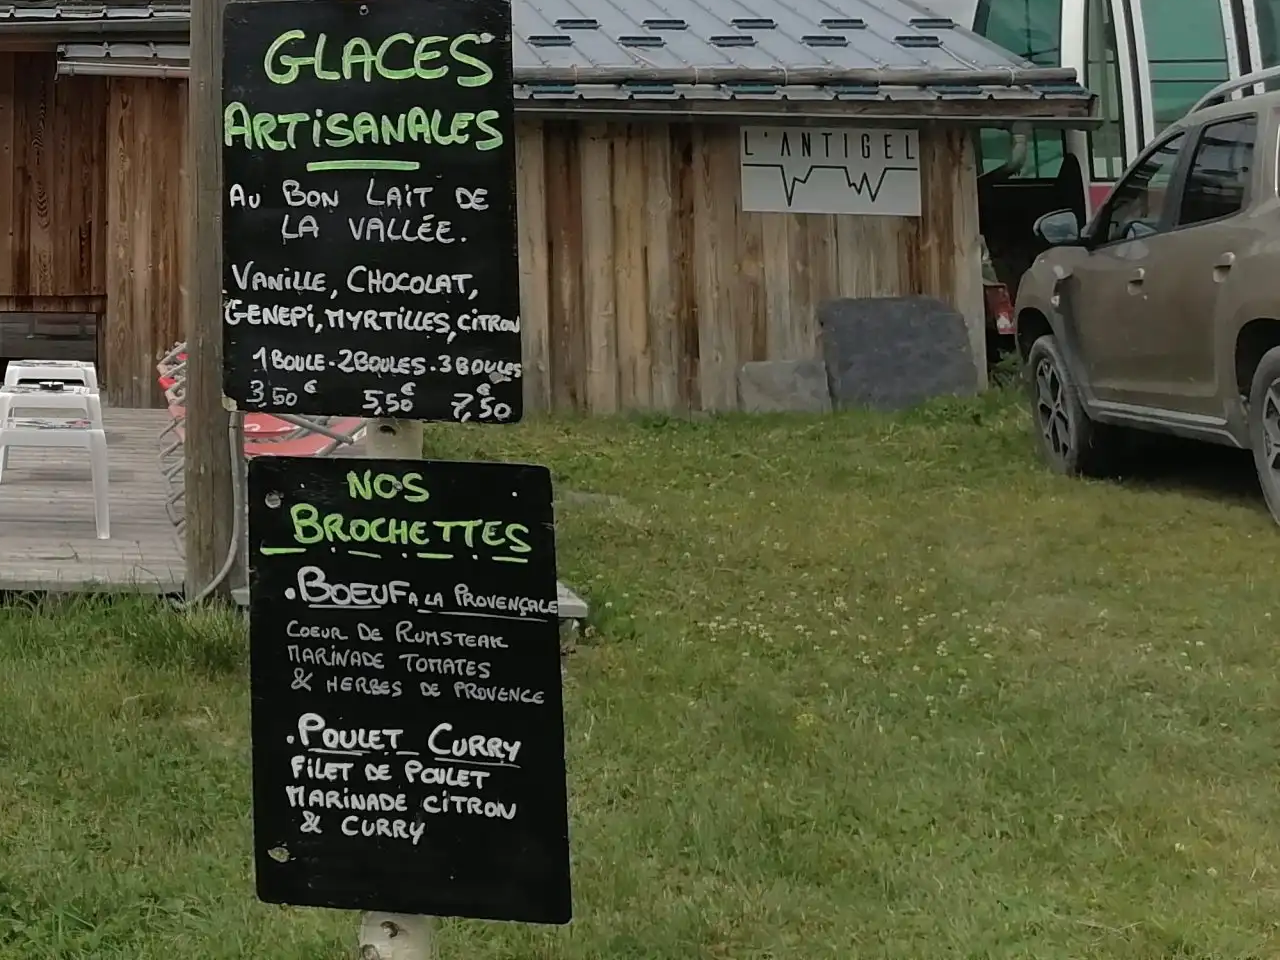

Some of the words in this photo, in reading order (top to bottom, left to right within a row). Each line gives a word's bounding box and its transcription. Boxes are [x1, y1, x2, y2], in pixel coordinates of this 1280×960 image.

[264, 29, 494, 87] GLACES
[224, 101, 504, 151] ARTISANALES
[744, 131, 915, 160] L'ANTIGEL
[230, 184, 260, 208] AU
[282, 179, 339, 207] BON
[366, 178, 433, 208] LAIT
[455, 188, 489, 210] DE
[281, 214, 319, 239] LA
[347, 469, 430, 503] NOS
[290, 503, 532, 553] BROCHETTES
[424, 591, 444, 608] LA
[454, 583, 558, 616] PROVENÇALE
[286, 620, 348, 641] COEUR
[357, 622, 383, 642] DE
[395, 620, 509, 649] RUMSTEAK
[287, 645, 385, 670] MARINADE
[399, 653, 492, 679] TOMATES
[290, 667, 313, 691] &
[326, 676, 403, 697] HERBES
[420, 682, 441, 697] DE
[454, 683, 545, 704] PROVENCE
[298, 712, 404, 750] POULET
[427, 722, 521, 762] CURRY
[291, 755, 354, 781] FILET
[364, 763, 392, 781] DE
[404, 760, 491, 790] POULET
[285, 785, 408, 812] MARINADE
[422, 790, 517, 820] CITRON
[300, 810, 322, 834] &
[341, 815, 426, 845] CURRY
